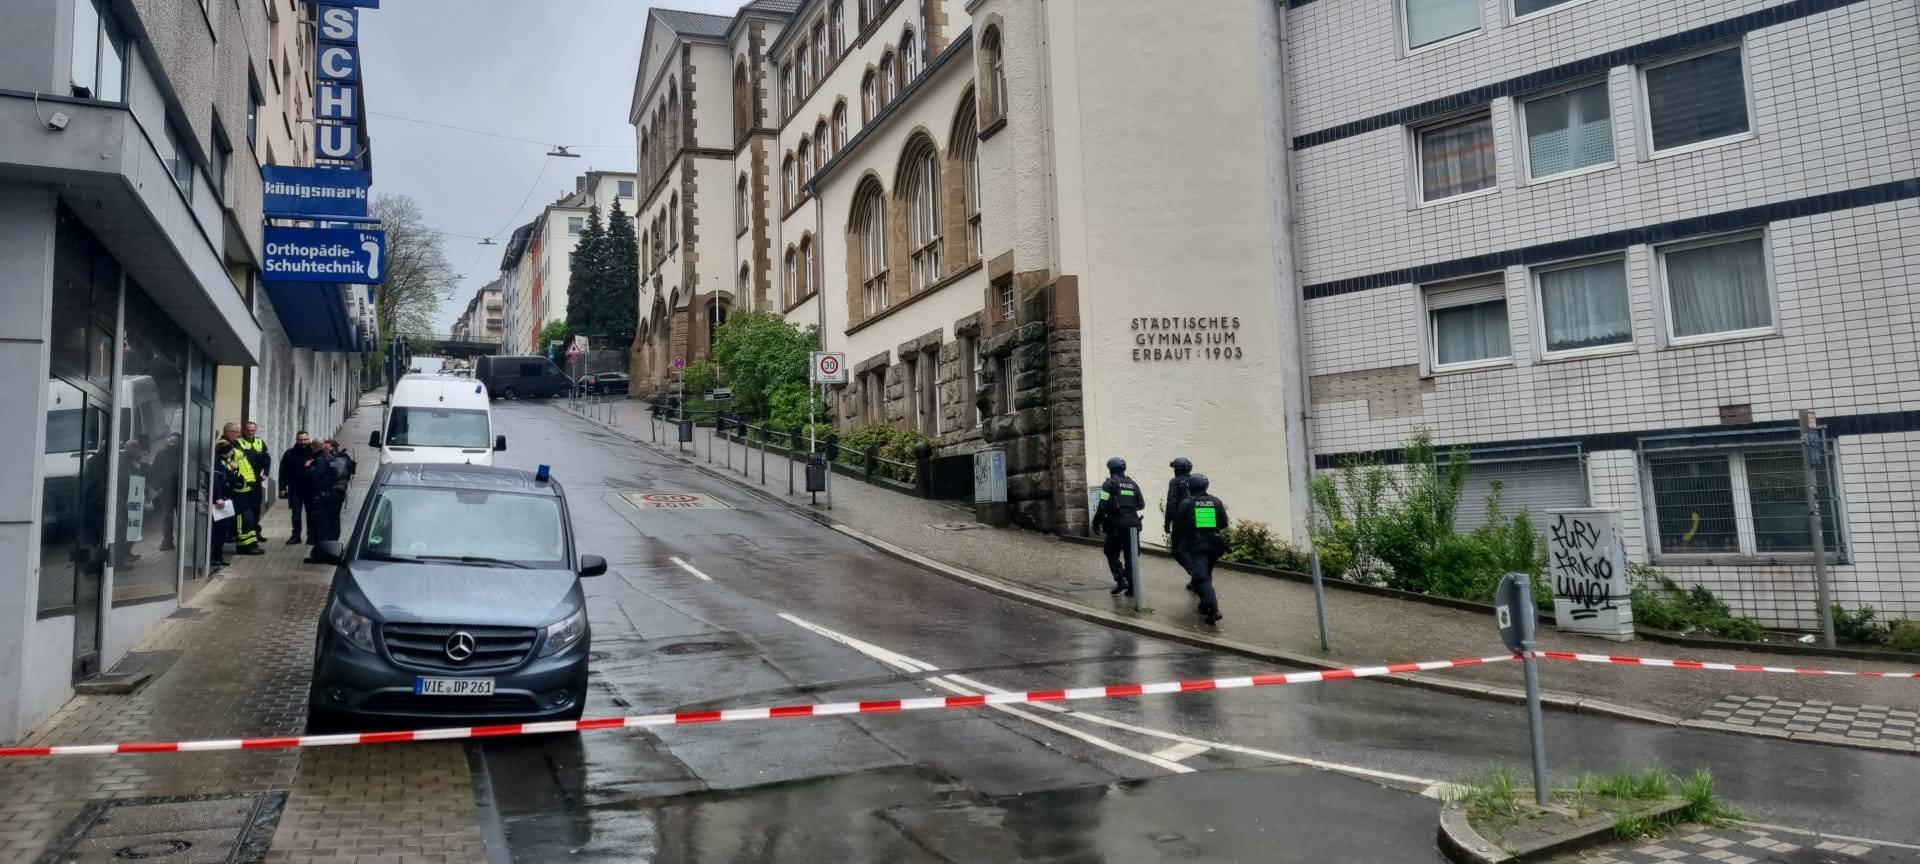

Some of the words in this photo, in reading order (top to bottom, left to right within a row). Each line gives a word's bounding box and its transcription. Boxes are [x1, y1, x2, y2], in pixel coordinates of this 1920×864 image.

[265, 182, 366, 199] königsmark
[266, 243, 355, 259] Orthopädie-
[266, 259, 365, 274] Schuhtechnik
[1131, 317, 1241, 330] STÄDTISCHES
[1136, 332, 1235, 345] GYMNASIUM
[824, 361, 835, 369] 30
[424, 680, 445, 694] VIE
[453, 680, 469, 694] DP
[470, 681, 491, 694] 261
